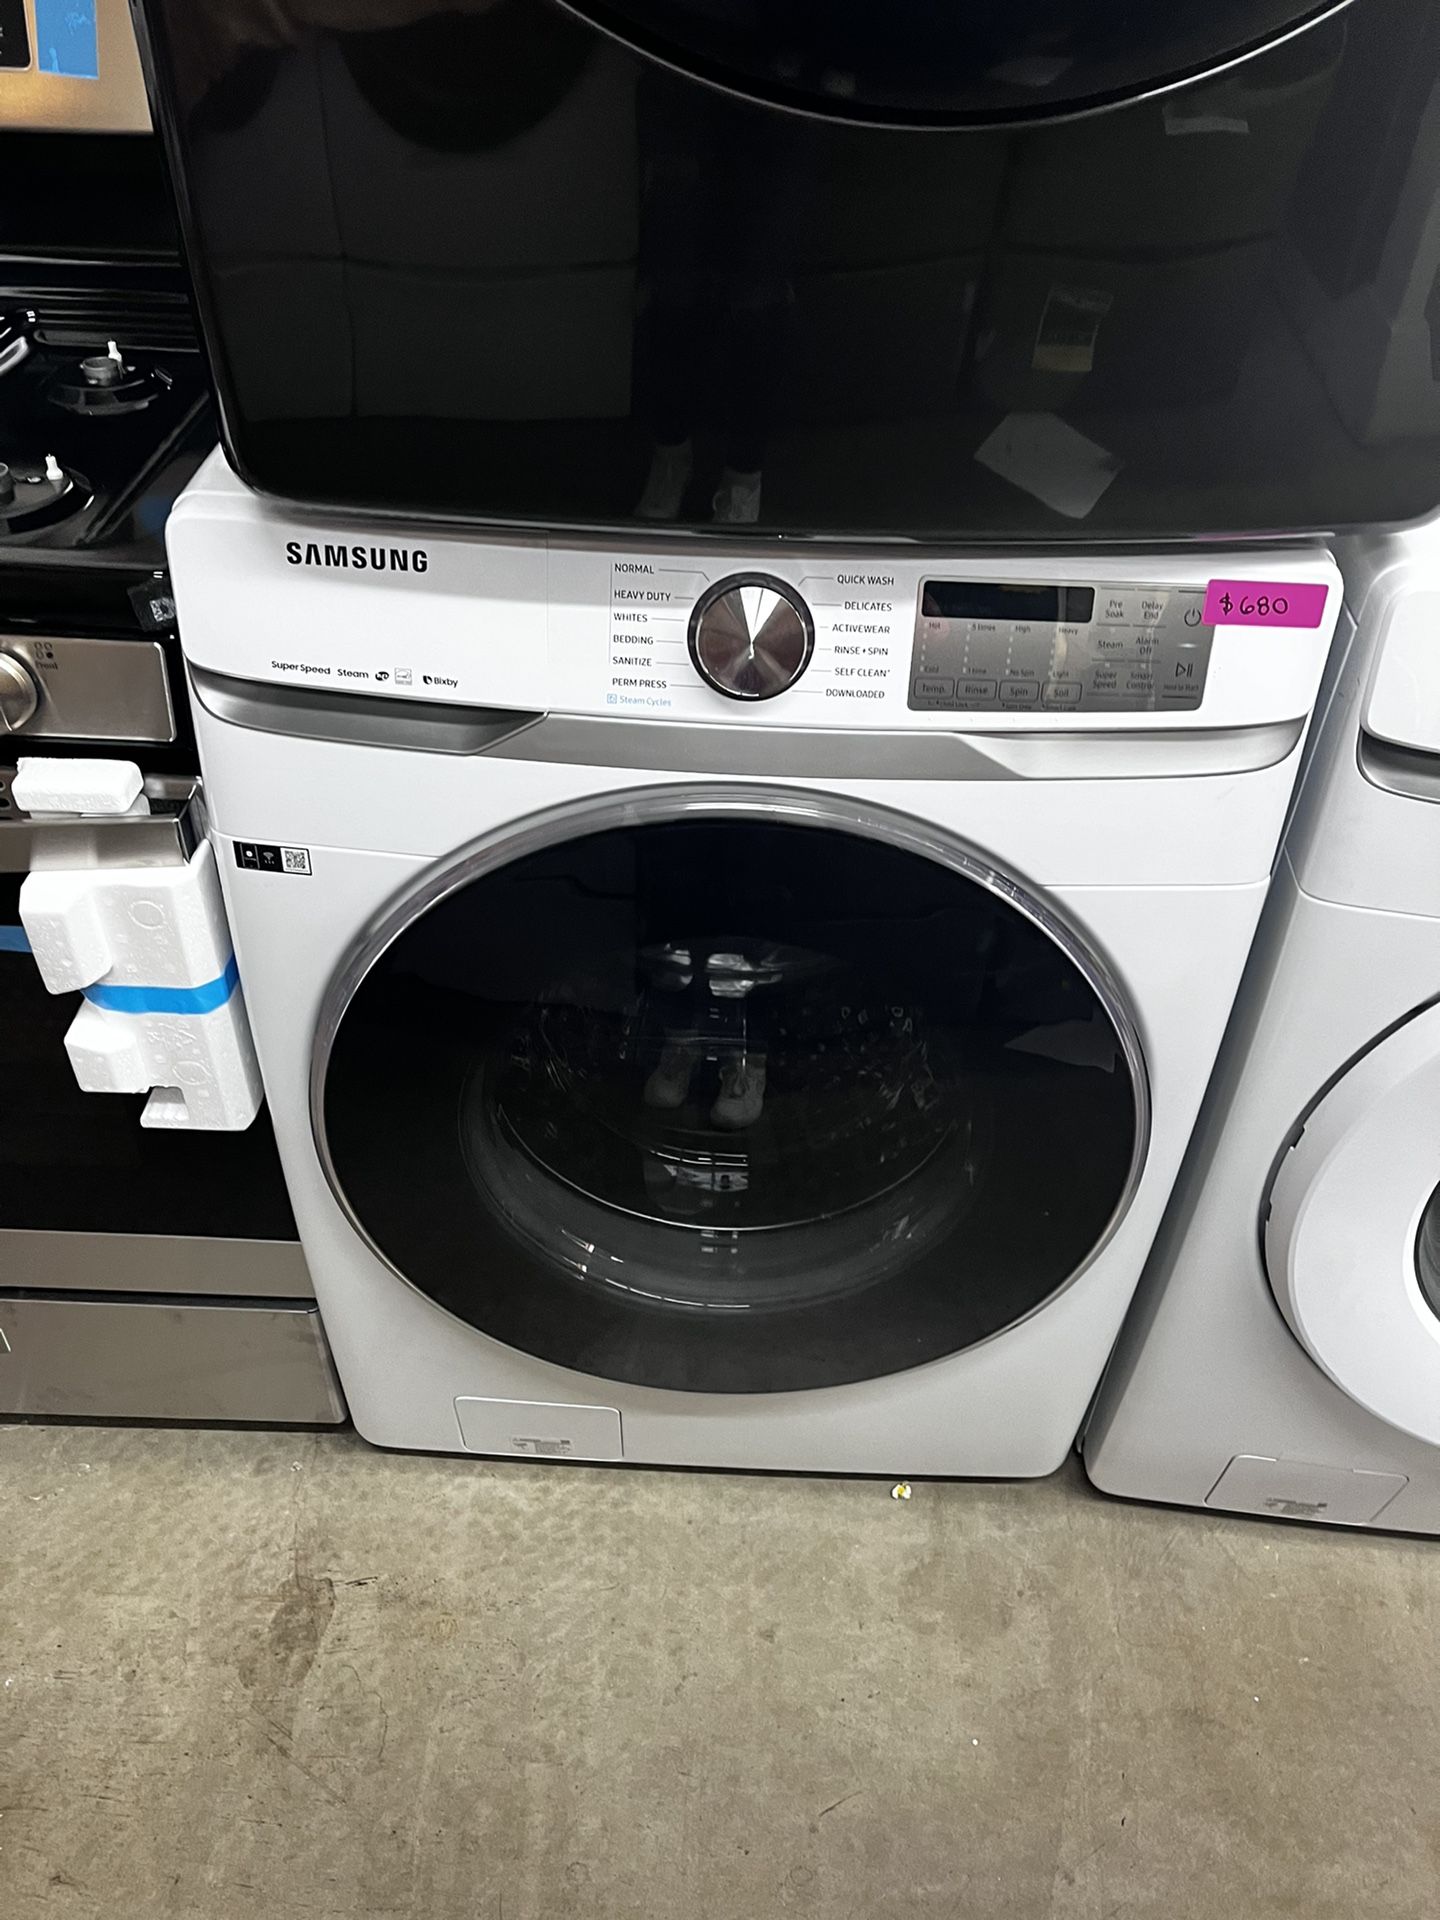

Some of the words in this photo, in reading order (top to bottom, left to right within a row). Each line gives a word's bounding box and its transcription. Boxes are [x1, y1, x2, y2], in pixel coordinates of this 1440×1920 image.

[286, 542, 428, 573] SAMSUNG
[614, 563, 654, 574] NORMAL
[837, 574, 865, 585] QUICK
[867, 575, 894, 586] WASH
[614, 589, 645, 600] HEAVY
[646, 591, 671, 602] DUTY
[844, 601, 892, 612] DELICATES
[1109, 600, 1123, 609] Pre
[1141, 601, 1164, 611] Delay
[613, 612, 648, 623] WHITES
[1105, 609, 1124, 619] Soak
[1143, 611, 1159, 620] End
[832, 623, 890, 634] ACTIVEWEAR
[613, 634, 654, 645] BEDDING
[1097, 640, 1124, 649] Steam
[1135, 636, 1160, 646] Alarm
[834, 645, 860, 655] RINSE
[867, 646, 888, 656] SPIN
[612, 656, 652, 667] SANITIZE
[271, 660, 299, 672] Super
[300, 663, 331, 675] Speed
[834, 667, 855, 676] SELF
[337, 668, 369, 679] Steam
[434, 677, 459, 688] Bixby
[612, 677, 637, 687] PERM
[639, 678, 667, 689] PRESS
[825, 688, 885, 699] DOWNLOADED
[965, 685, 988, 695] Rinse
[1010, 686, 1029, 697] Spin
[1054, 688, 1070, 698] Soil
[619, 695, 645, 704] Steam
[646, 696, 671, 707] Cycles
